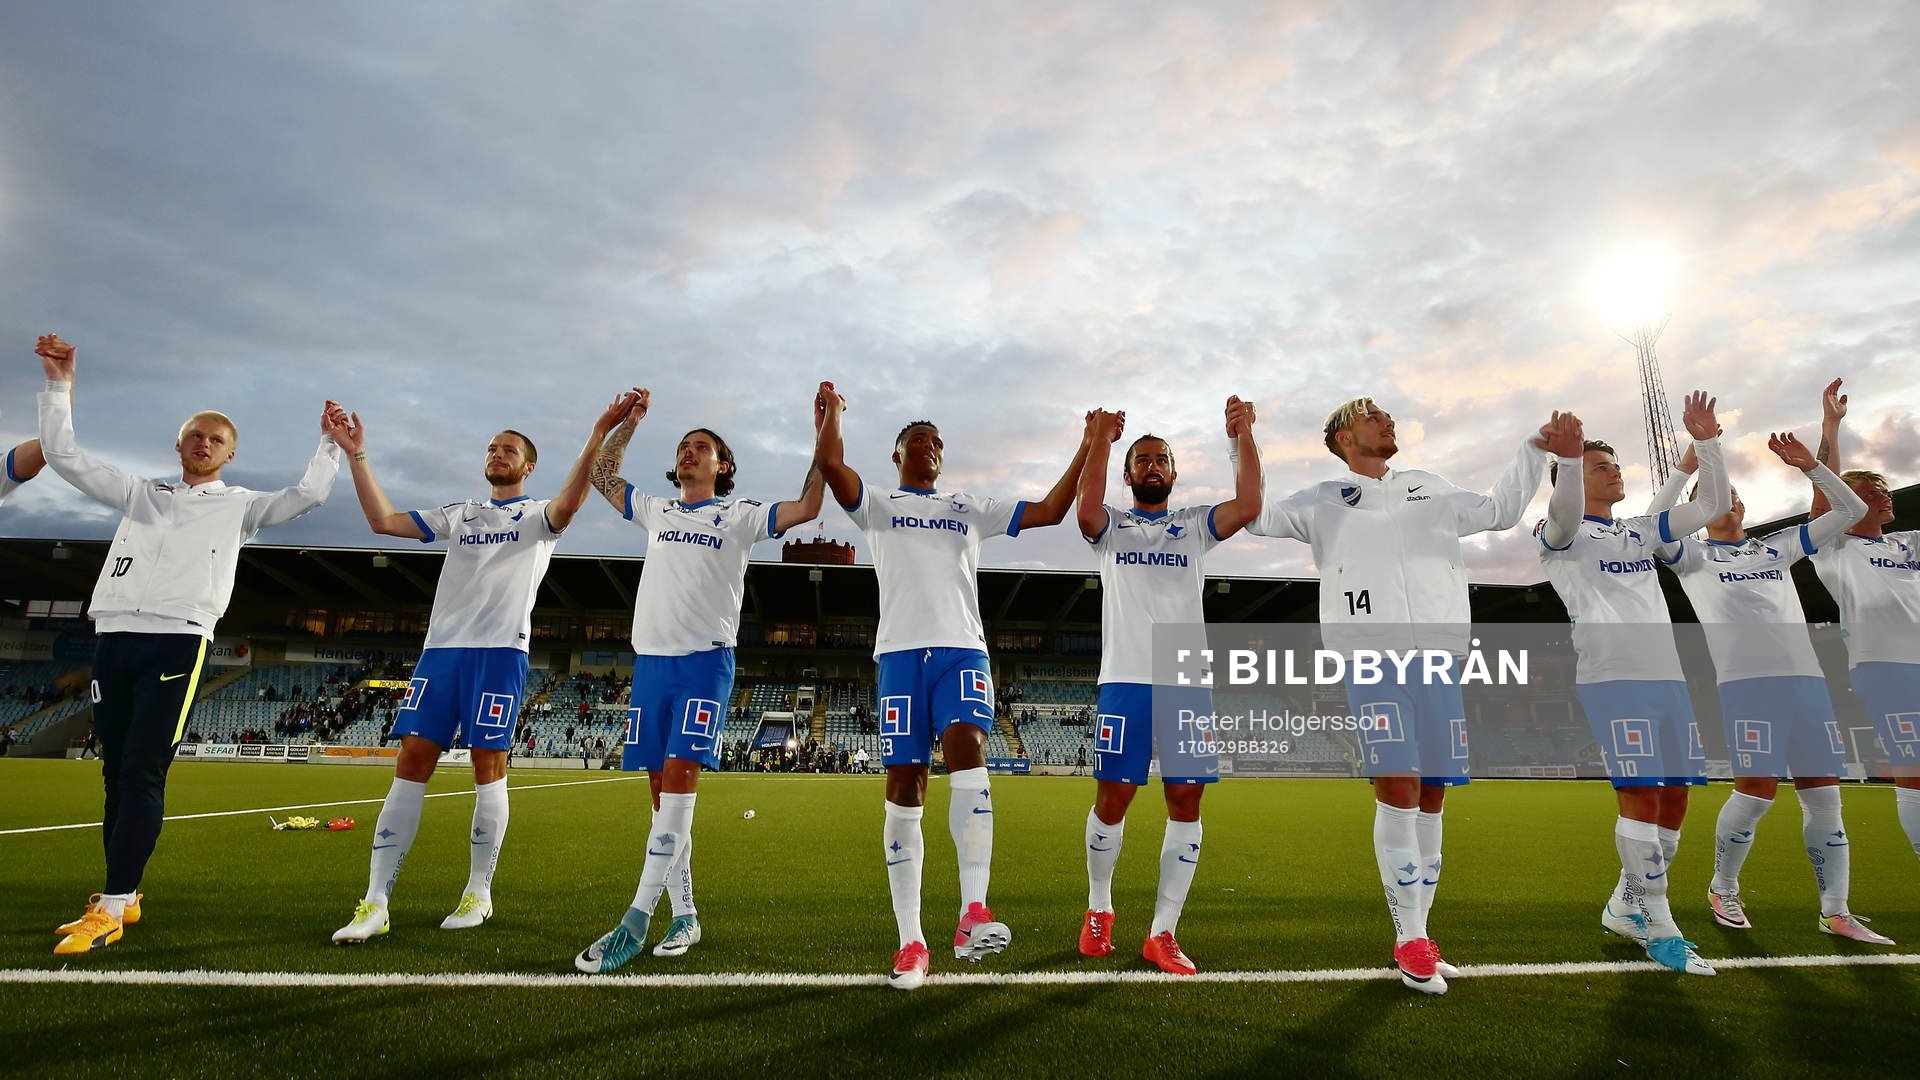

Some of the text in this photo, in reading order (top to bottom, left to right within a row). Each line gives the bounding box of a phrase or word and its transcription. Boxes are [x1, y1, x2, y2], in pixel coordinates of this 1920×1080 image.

[892, 516, 968, 536] HOLMEN
[459, 531, 520, 546] HOLMEN
[657, 530, 724, 550] HOLMEN
[111, 557, 133, 578] 10
[1115, 552, 1188, 568] HOLMEN
[1719, 570, 1783, 583] HOLMEN
[1343, 589, 1372, 616] 14
[204, 746, 234, 755] SEFAB
[880, 738, 894, 757] 23
[1617, 760, 1638, 778] 10
[1736, 753, 1752, 768] 18
